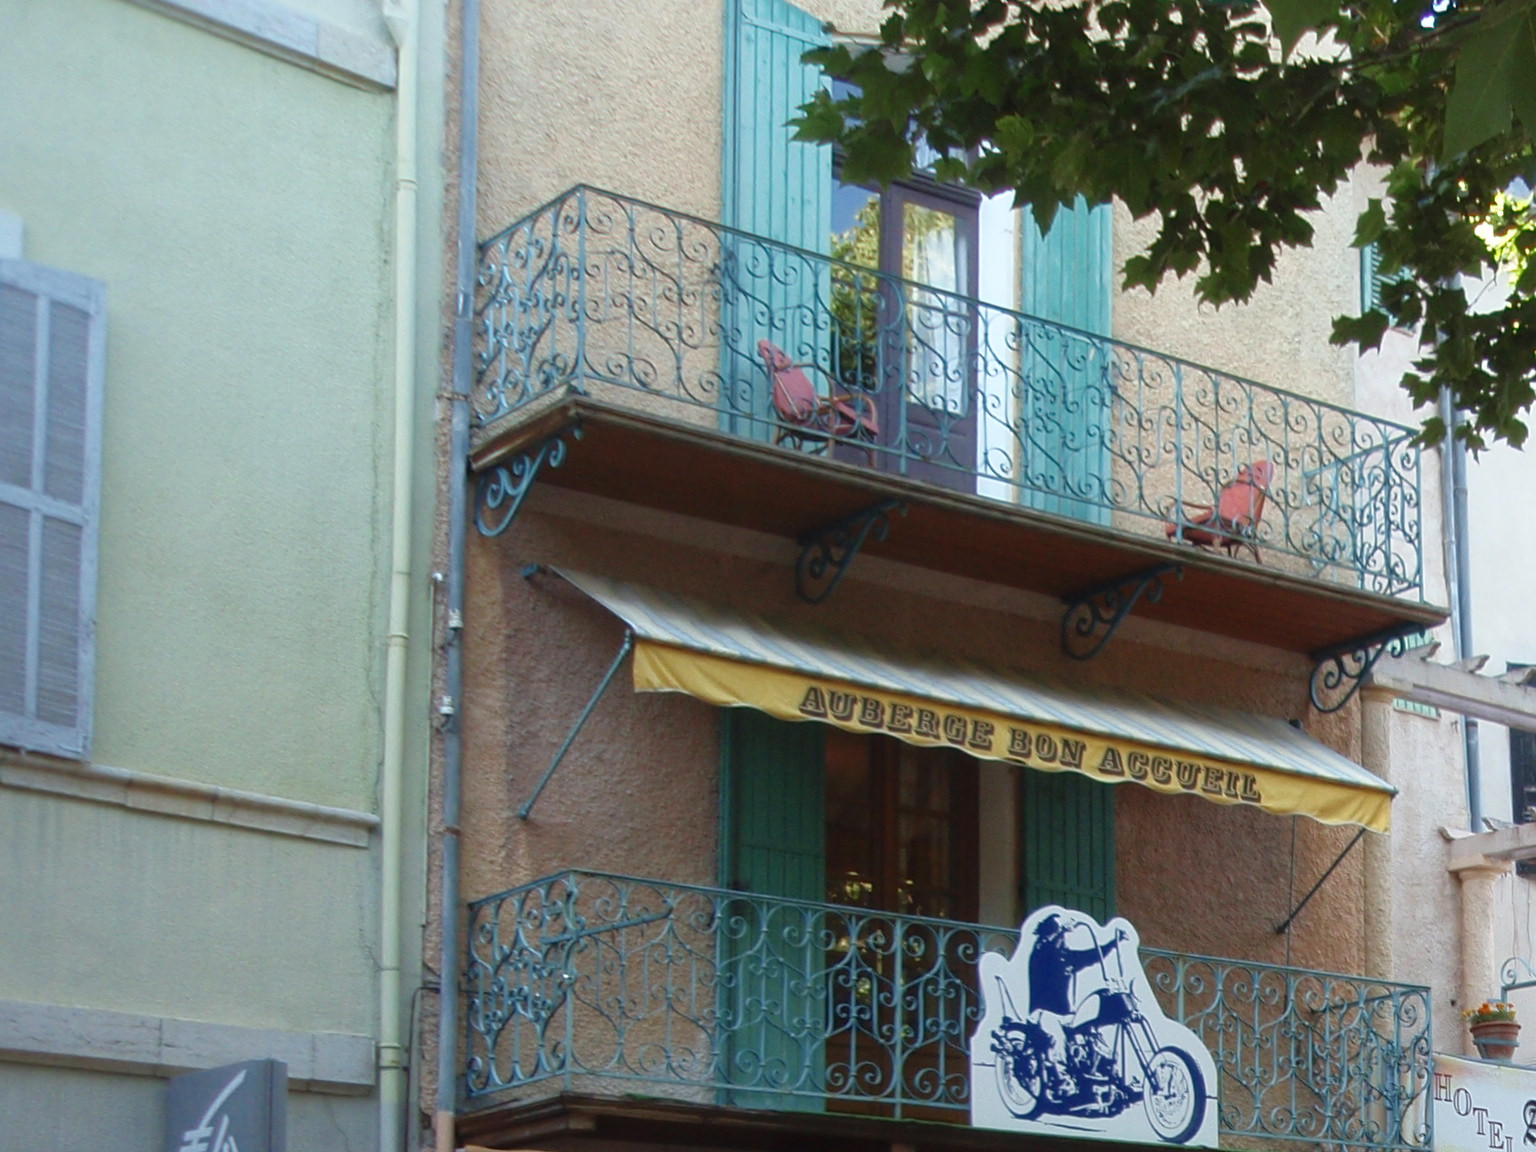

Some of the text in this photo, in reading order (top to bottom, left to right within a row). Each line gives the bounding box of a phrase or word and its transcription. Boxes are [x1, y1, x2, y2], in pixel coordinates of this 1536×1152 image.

[799, 685, 1263, 803] AUBERGE BON ACCUEIL
